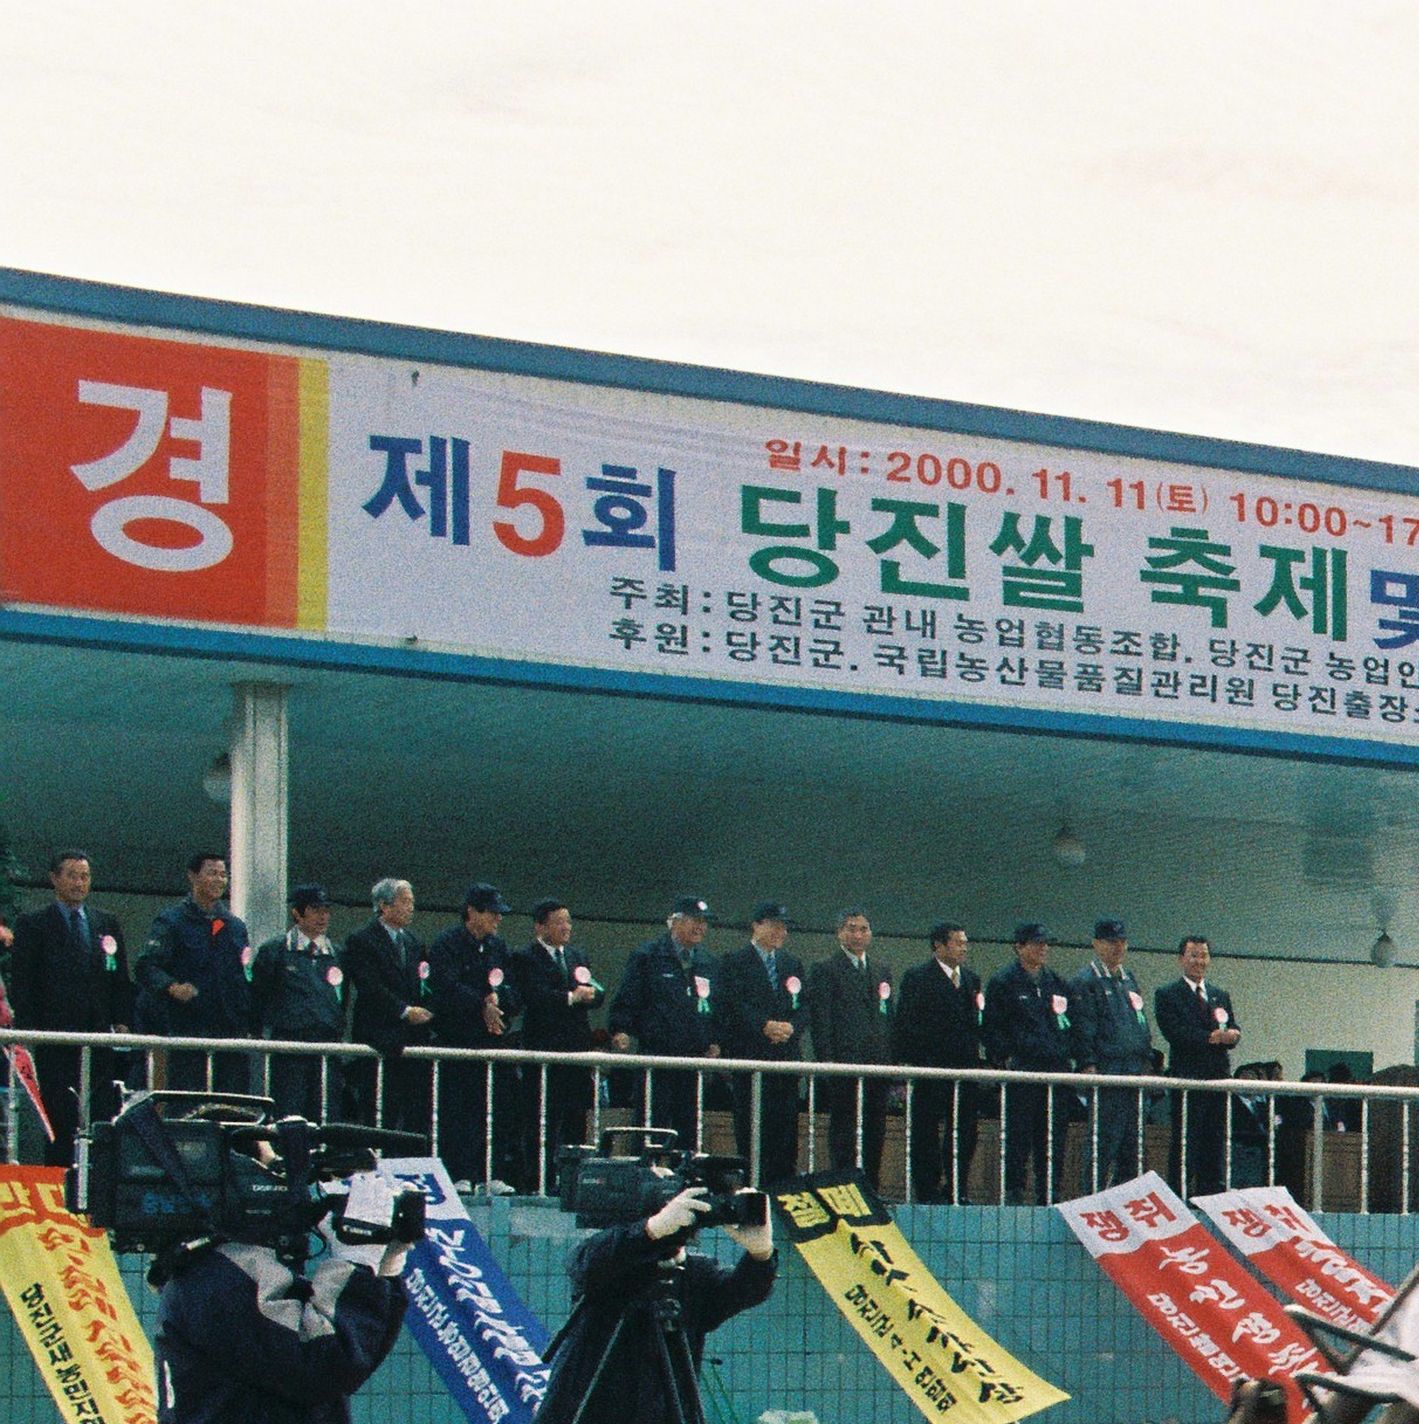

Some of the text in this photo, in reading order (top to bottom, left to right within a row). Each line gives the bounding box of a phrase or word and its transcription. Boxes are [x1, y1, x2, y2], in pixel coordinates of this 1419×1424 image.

[70, 379, 235, 573] 경
[886, 451, 1016, 498] 2000.
[362, 433, 677, 572] 제5회
[739, 481, 1095, 614] 당진쌀
[726, 589, 845, 632] 당진군
[862, 603, 938, 640] 관내
[1209, 635, 1312, 678] 당진군
[873, 644, 1256, 708] 국립농산물품질관리원
